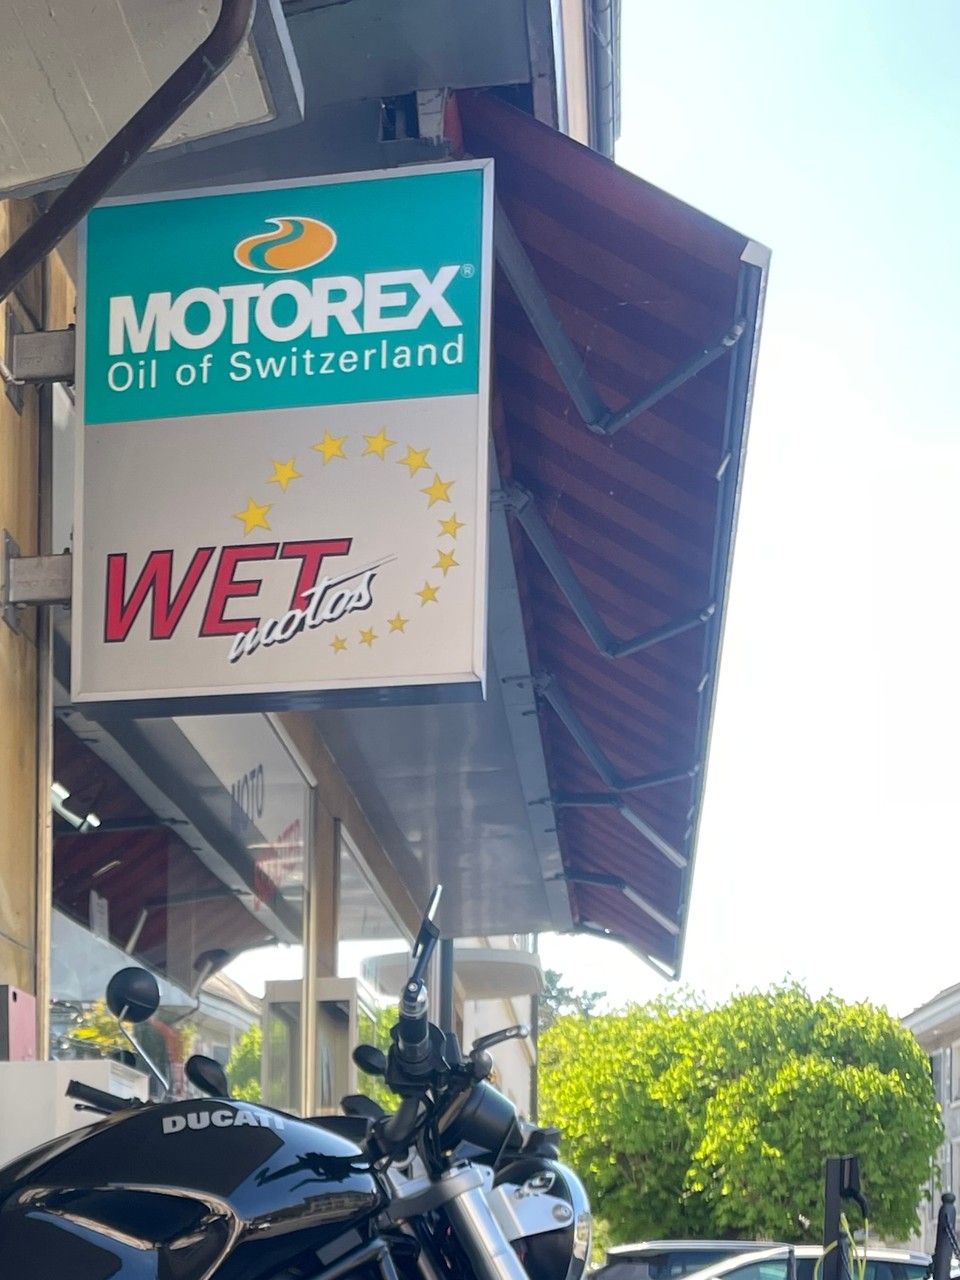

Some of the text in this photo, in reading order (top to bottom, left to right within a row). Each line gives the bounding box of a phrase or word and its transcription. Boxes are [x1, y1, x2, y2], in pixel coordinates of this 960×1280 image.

[107, 264, 463, 357] MOTOREX
[107, 334, 464, 394] Oil of Switzerland
[103, 537, 354, 644] WET
[162, 1110, 285, 1134] DUCATI
